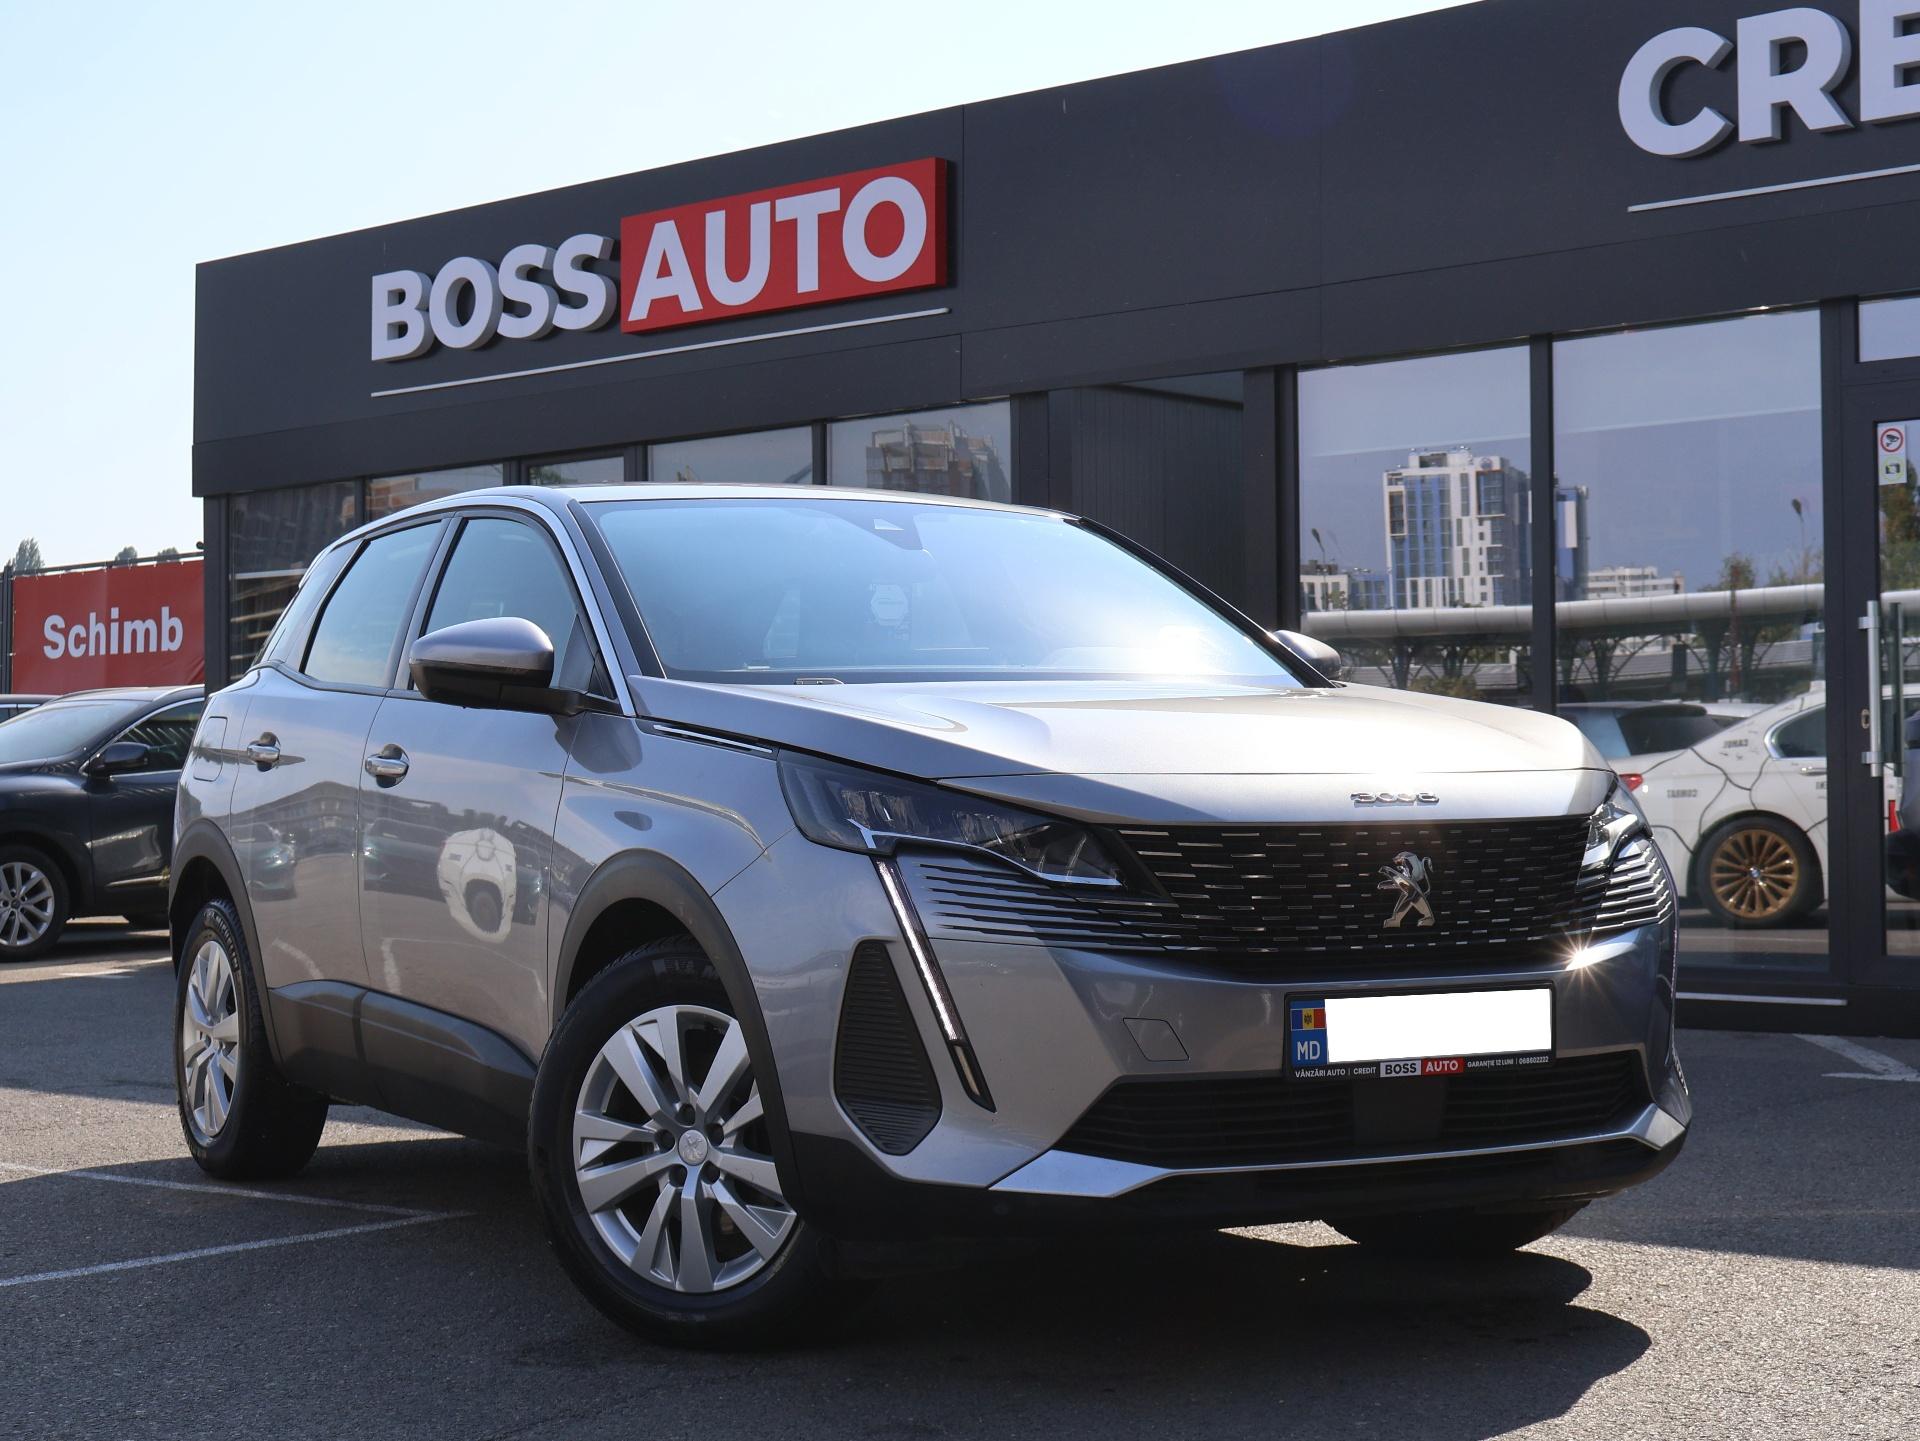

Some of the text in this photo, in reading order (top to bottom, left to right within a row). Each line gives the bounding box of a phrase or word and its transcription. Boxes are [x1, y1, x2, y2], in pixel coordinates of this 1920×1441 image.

[371, 176, 927, 362] BOSS AUTO
[43, 605, 183, 659] Schimb
[1350, 791, 1440, 808] 3008
[1297, 1040, 1320, 1060] MD
[1326, 1068, 1346, 1077] AUTO
[1353, 1066, 1377, 1075] CREDIT
[1385, 1063, 1417, 1075] BOSS
[1425, 1060, 1459, 1073] AUTO
